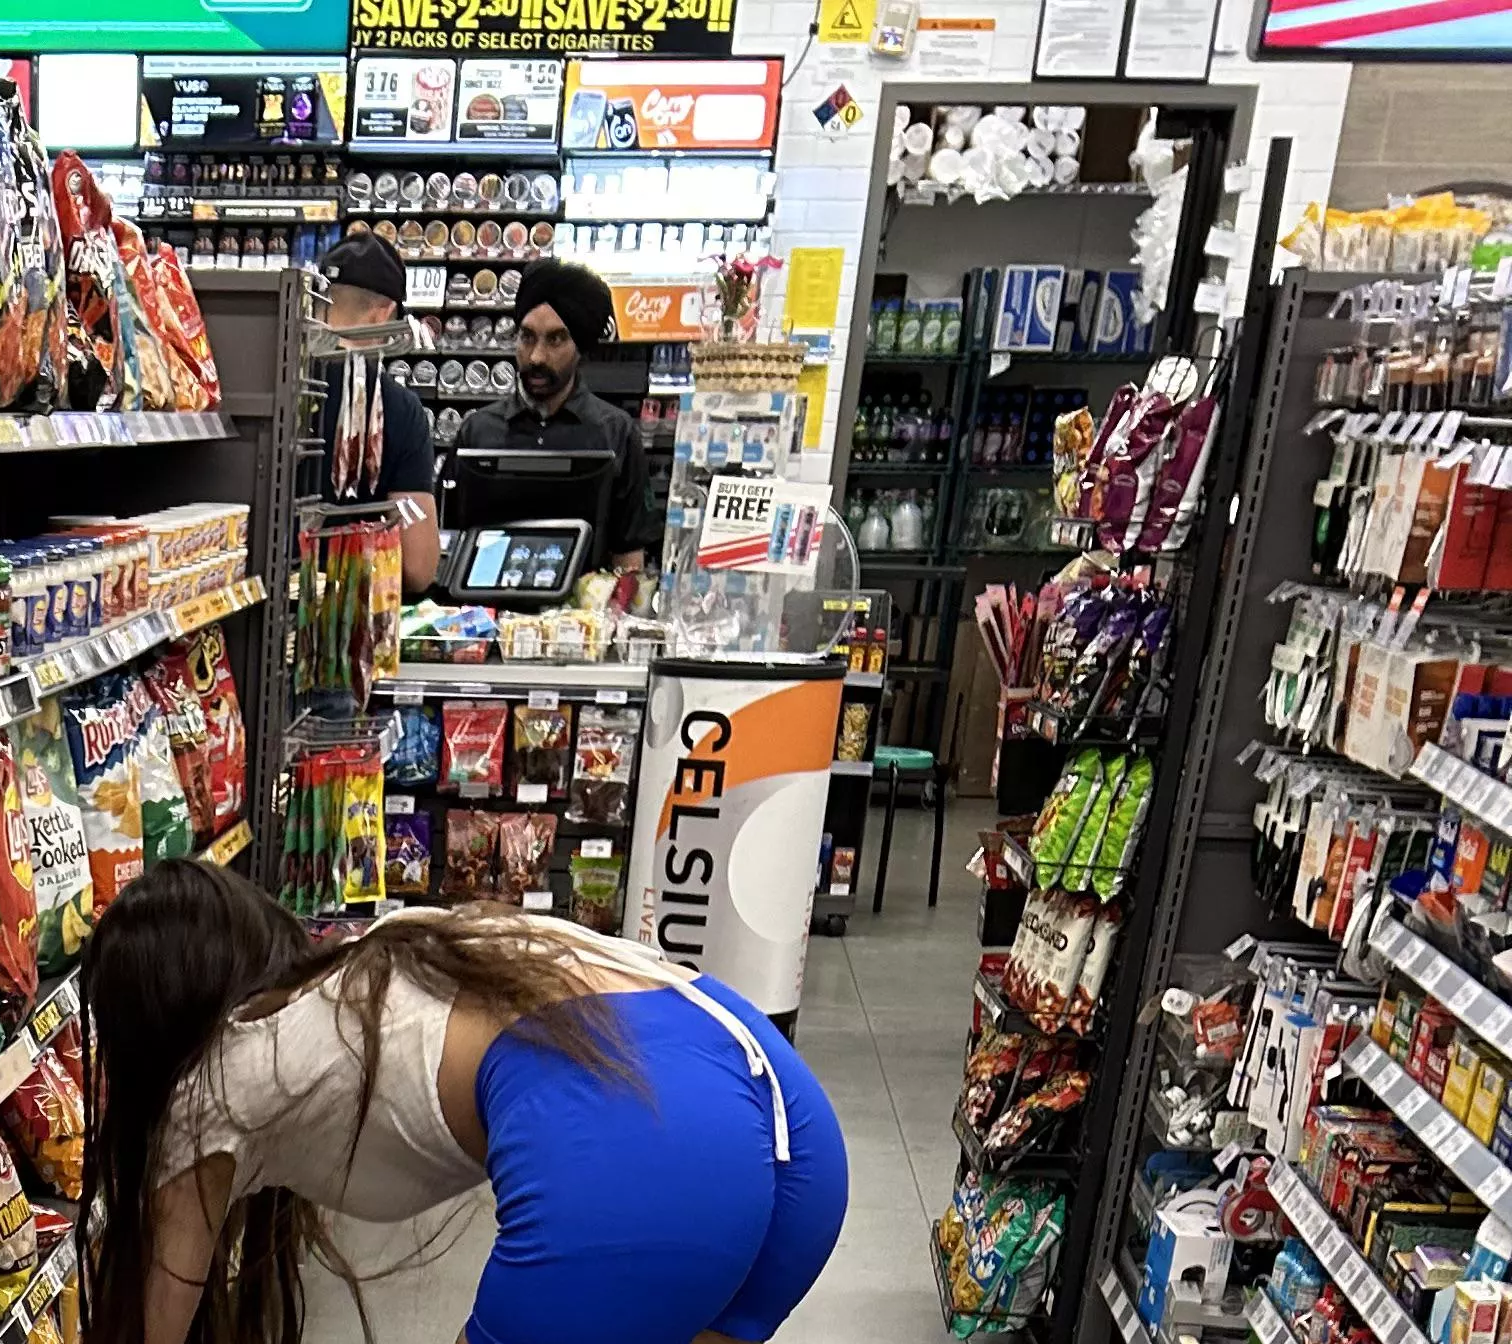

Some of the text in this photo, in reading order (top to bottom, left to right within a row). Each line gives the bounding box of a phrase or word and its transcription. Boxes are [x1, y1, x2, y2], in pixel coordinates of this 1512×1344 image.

[376, 32, 655, 52] 2 PACKS OF SELECT CIGARETTES
[717, 482, 741, 494] BUY
[748, 486, 767, 497] GET
[712, 495, 771, 522] FREE
[29, 806, 74, 848] Kettle
[30, 830, 85, 874] Cooked
[638, 886, 658, 944] LIVE
